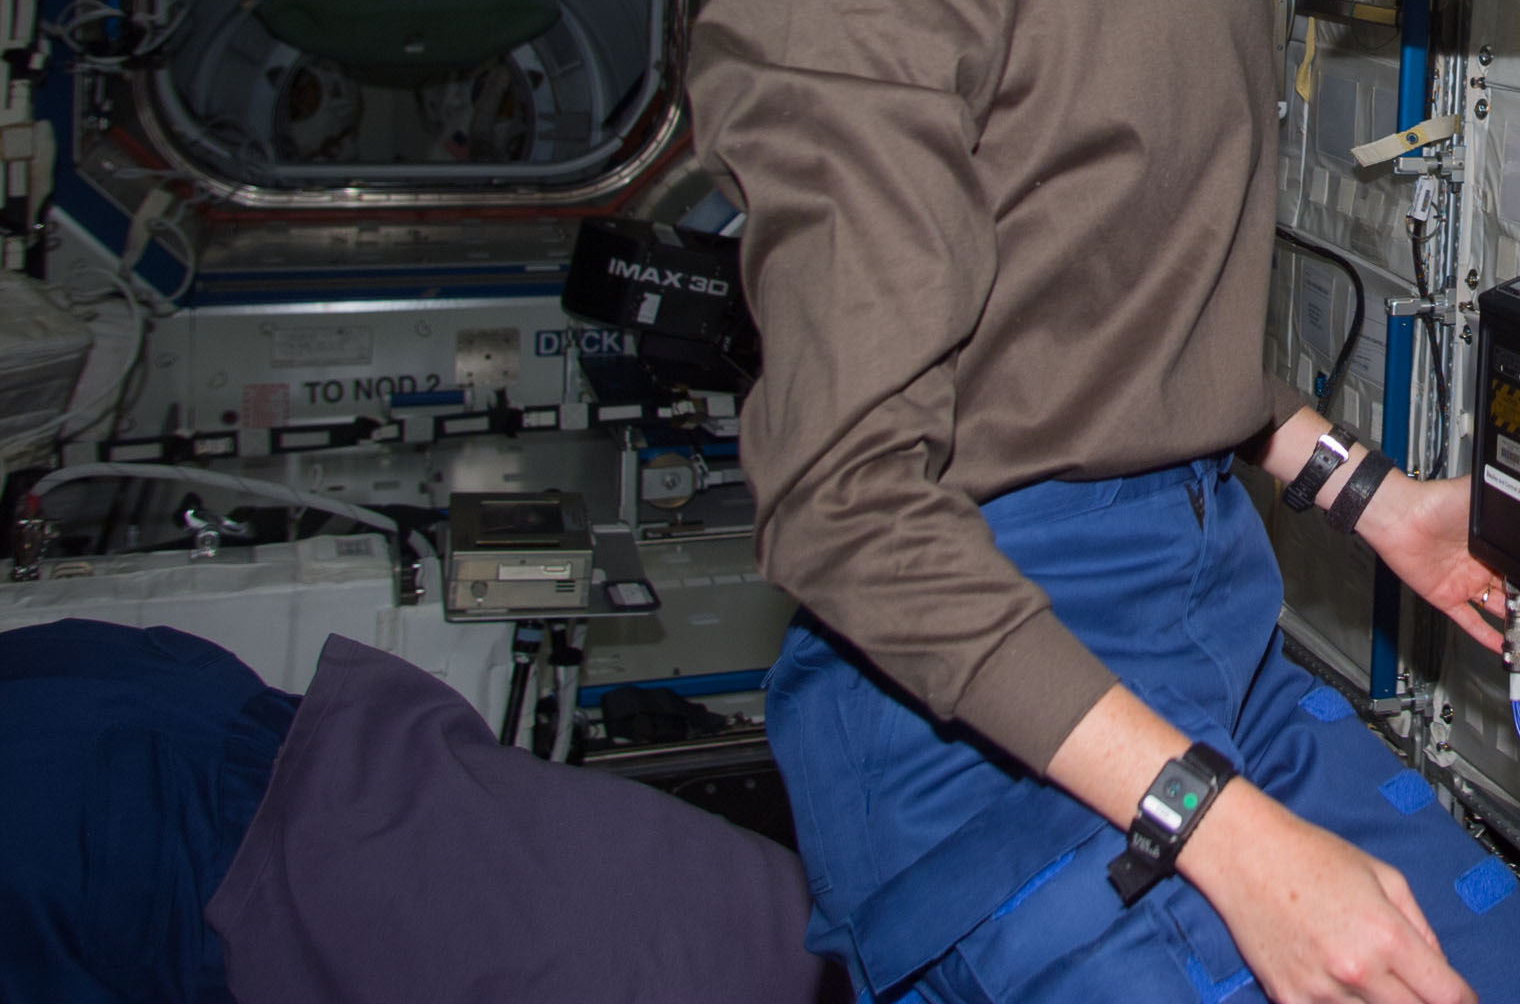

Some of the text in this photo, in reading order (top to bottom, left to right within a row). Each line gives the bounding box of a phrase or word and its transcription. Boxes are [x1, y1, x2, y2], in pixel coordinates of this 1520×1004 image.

[608, 257, 729, 296] IMAX 3D
[539, 330, 622, 355] DCK
[303, 379, 345, 405] TO
